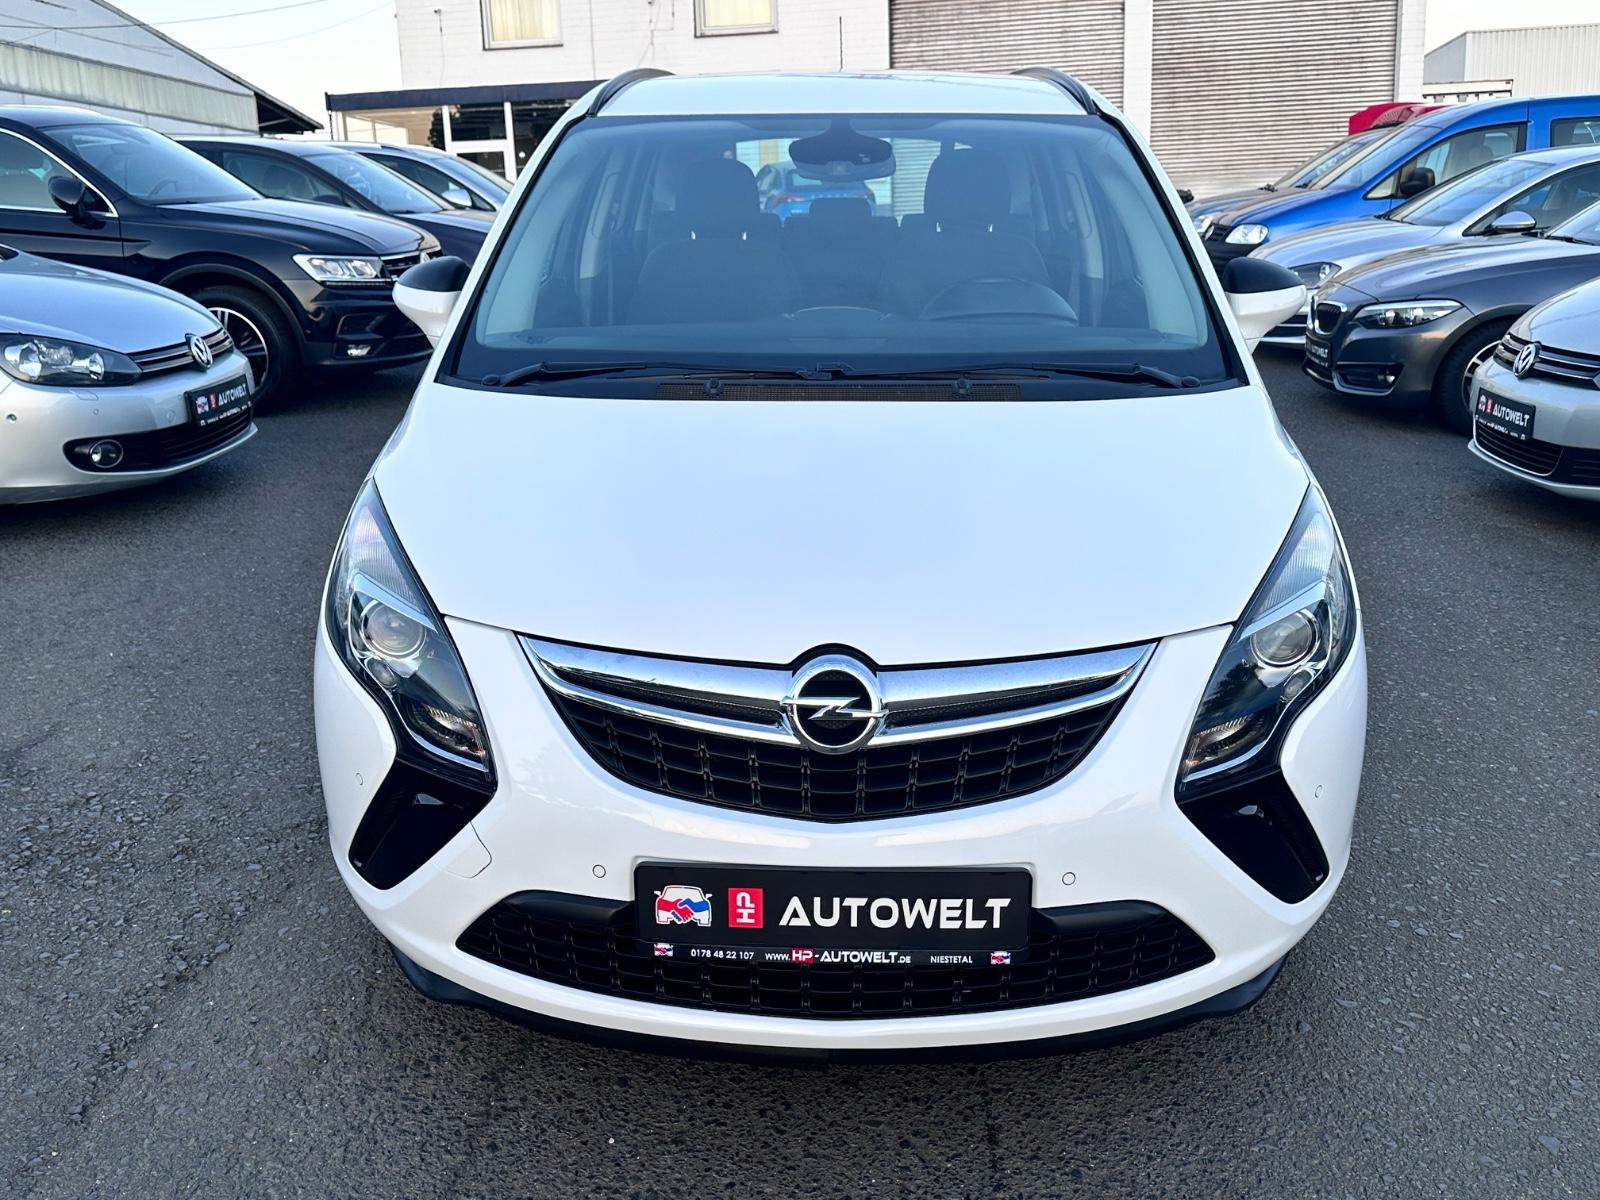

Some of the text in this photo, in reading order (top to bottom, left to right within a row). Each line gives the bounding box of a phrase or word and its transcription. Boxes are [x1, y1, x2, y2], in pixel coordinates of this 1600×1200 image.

[218, 383, 247, 406] AUTOWELT
[1492, 403, 1530, 427] AUTOWELT
[736, 891, 1011, 929] HP AUTOWELT
[690, 949, 711, 958] 0178
[713, 950, 724, 958] 48
[726, 951, 737, 959] 22
[739, 951, 754, 960] 107
[930, 955, 973, 964] NIESTETAL
